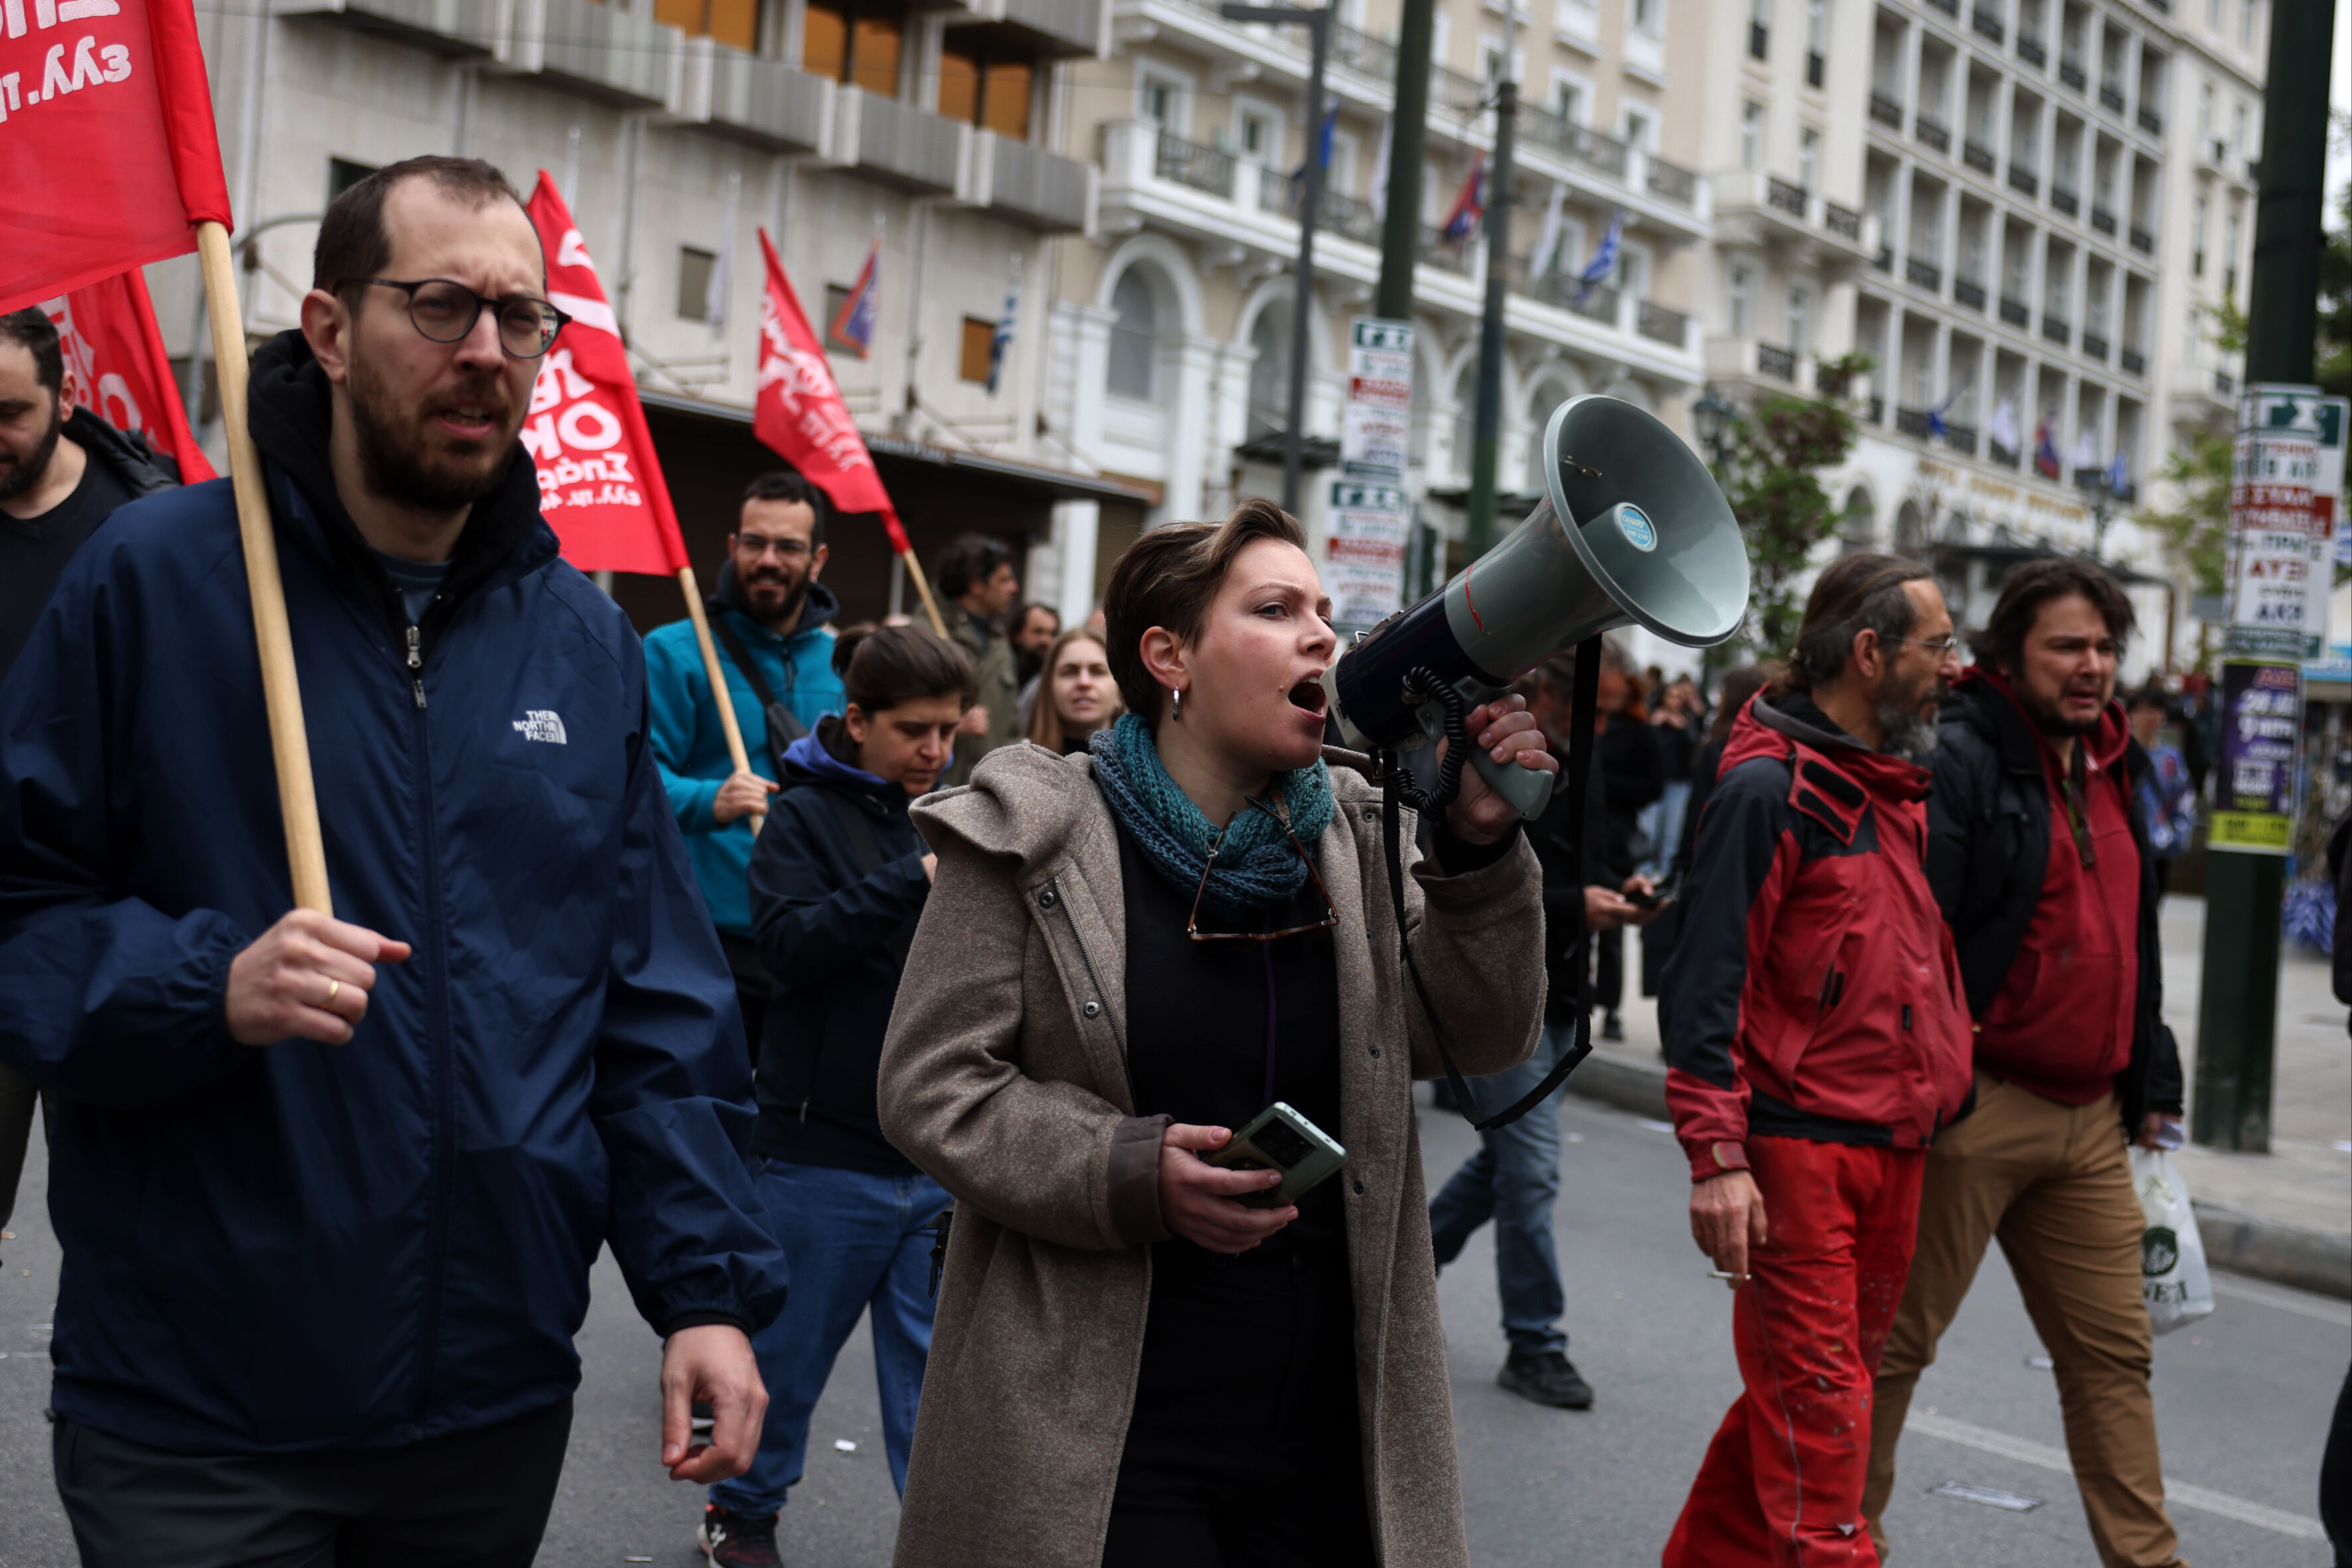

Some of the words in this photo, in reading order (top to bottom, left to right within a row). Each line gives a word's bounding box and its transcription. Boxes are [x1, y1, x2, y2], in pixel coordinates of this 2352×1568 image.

[525, 710, 550, 721] THE
[512, 720, 551, 732] NORTH
[525, 730, 553, 742] FACE
